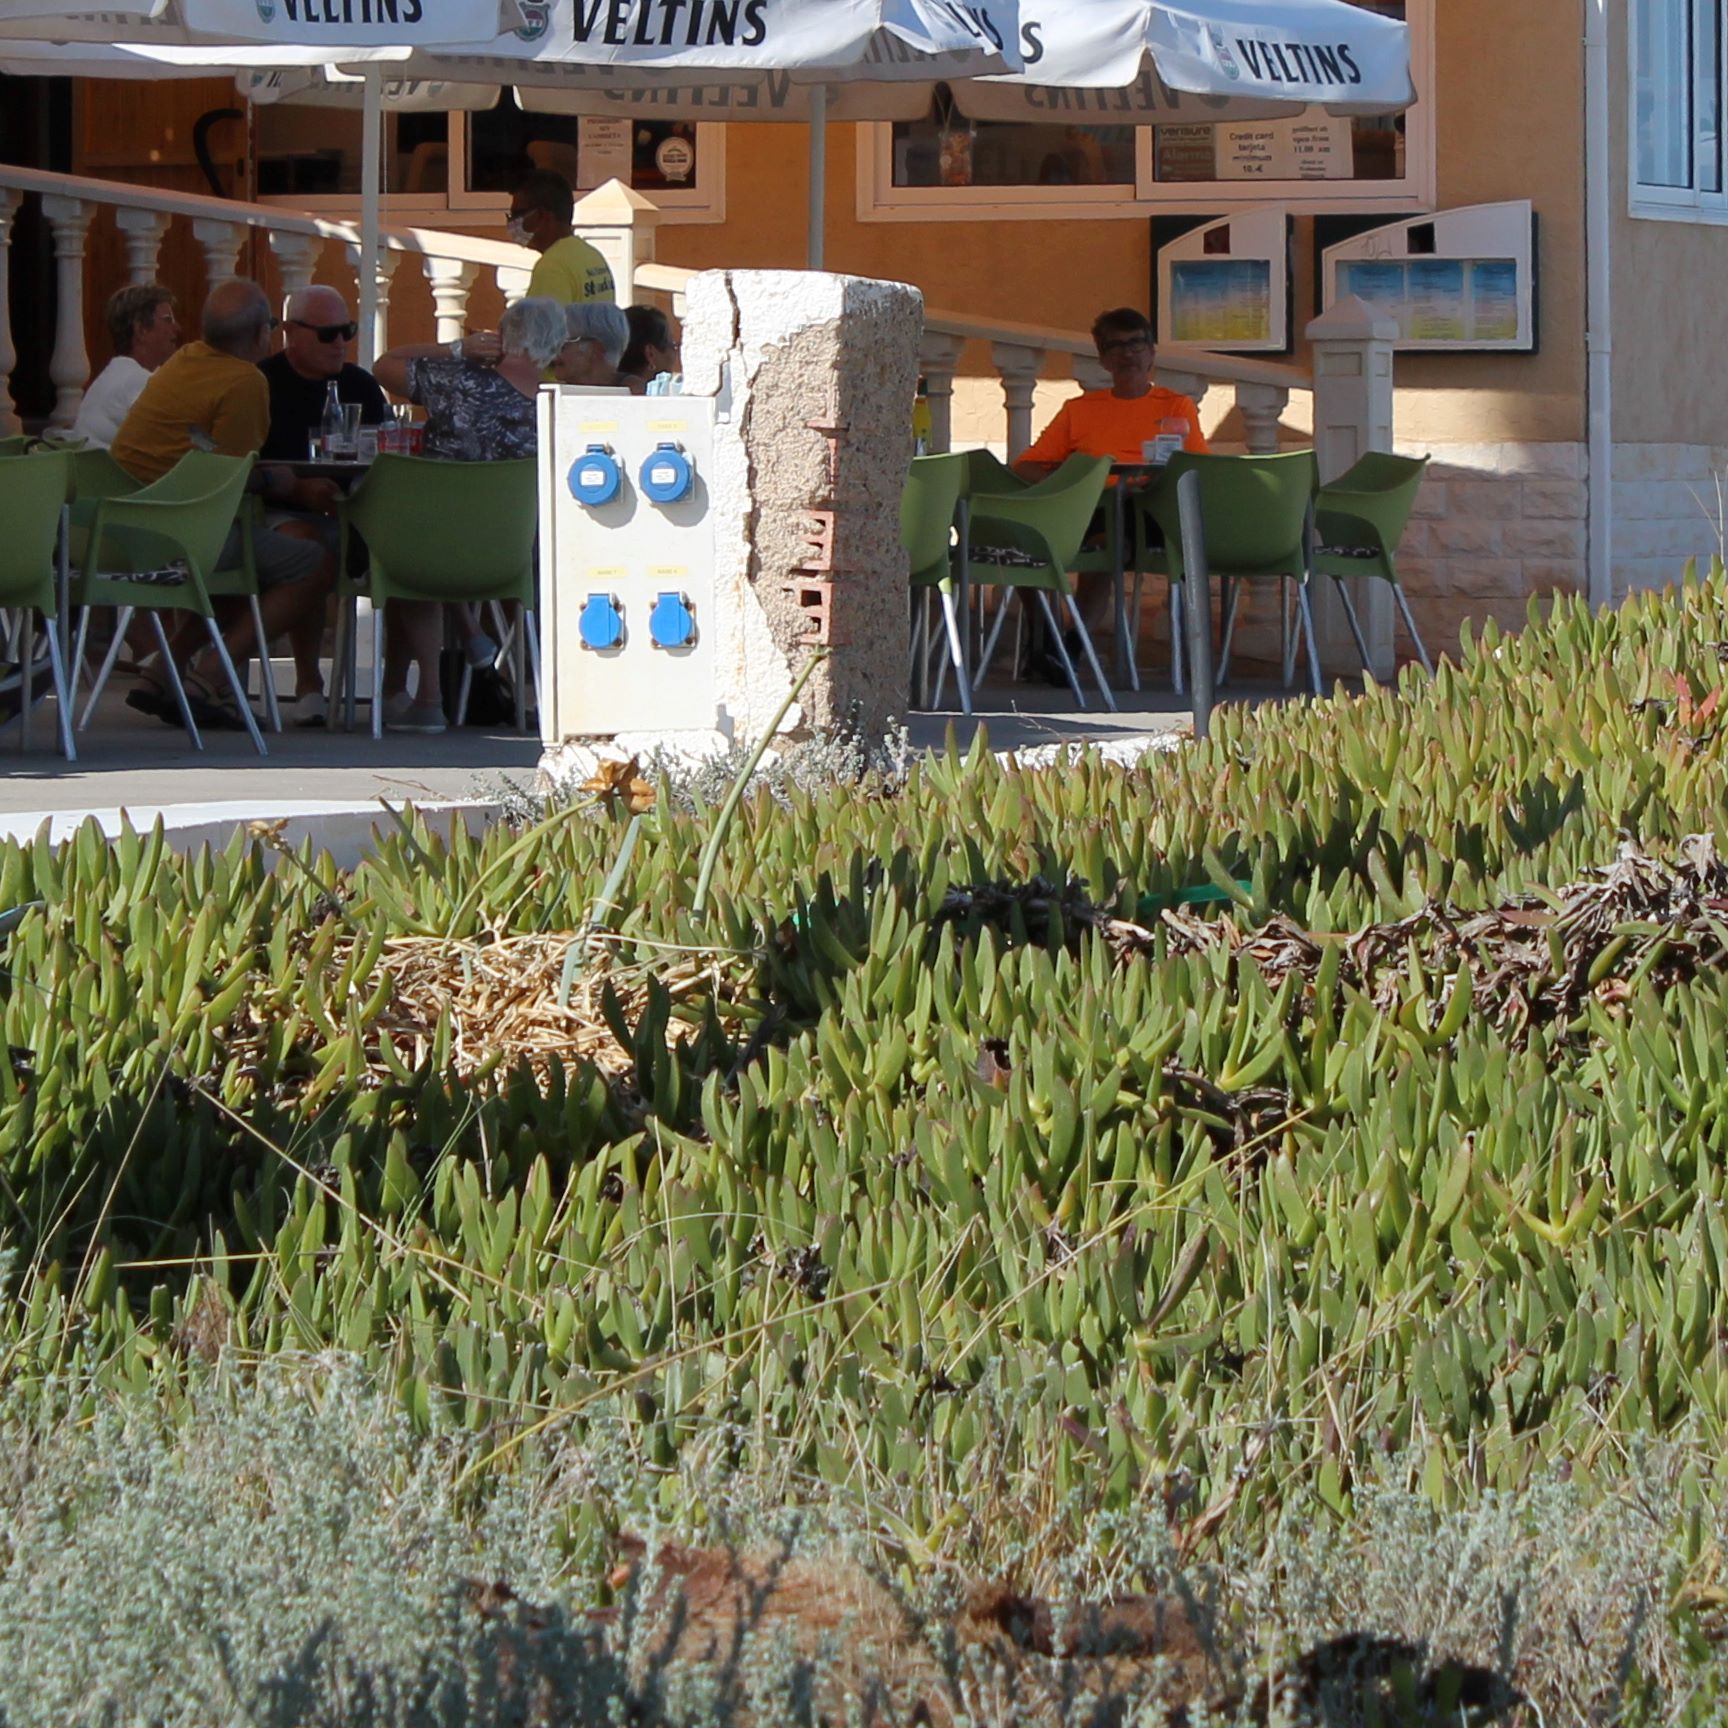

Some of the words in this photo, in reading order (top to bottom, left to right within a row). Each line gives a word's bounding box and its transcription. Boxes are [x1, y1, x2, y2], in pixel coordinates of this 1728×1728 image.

[1235, 38, 1362, 85] VELTINS
[1229, 131, 1254, 141] Credit
[1255, 131, 1274, 140] card
